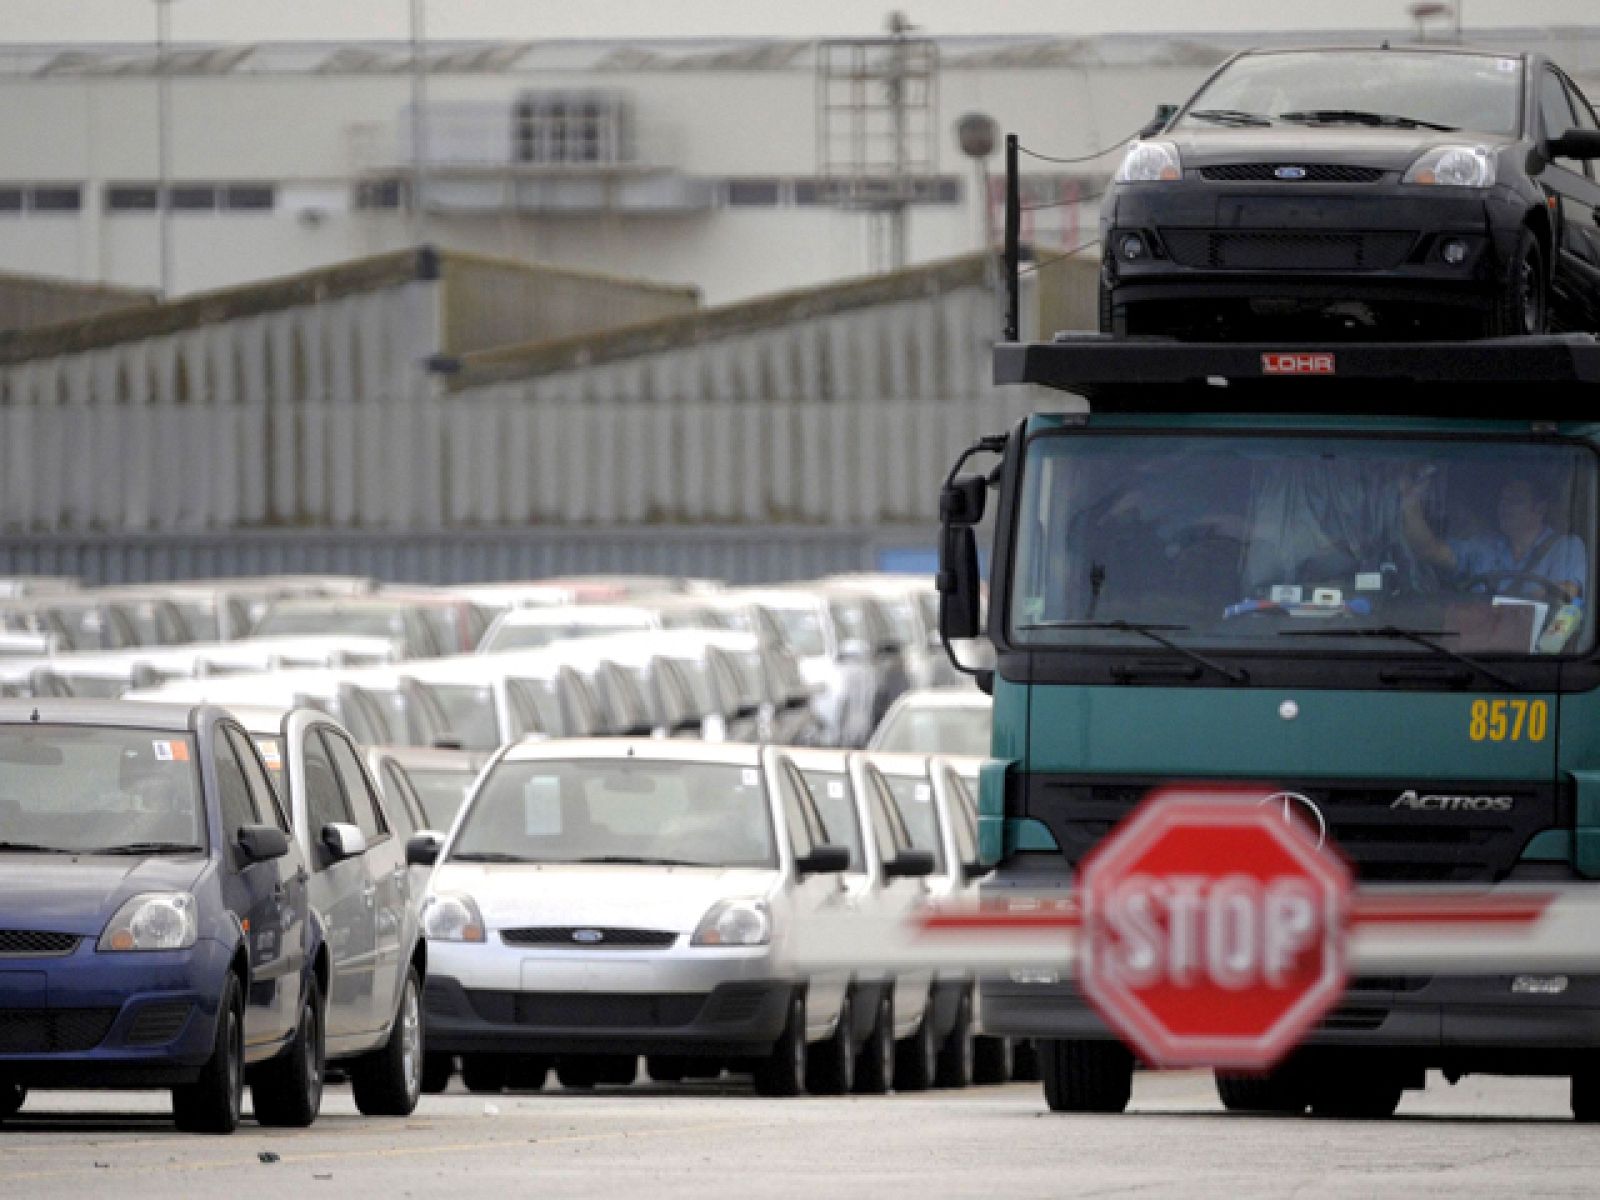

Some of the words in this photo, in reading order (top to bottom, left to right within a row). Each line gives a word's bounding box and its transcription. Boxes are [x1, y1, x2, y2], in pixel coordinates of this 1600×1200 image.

[1264, 355, 1333, 373] LOHR
[1468, 699, 1548, 741] 8570
[1103, 873, 1315, 989] STOP
